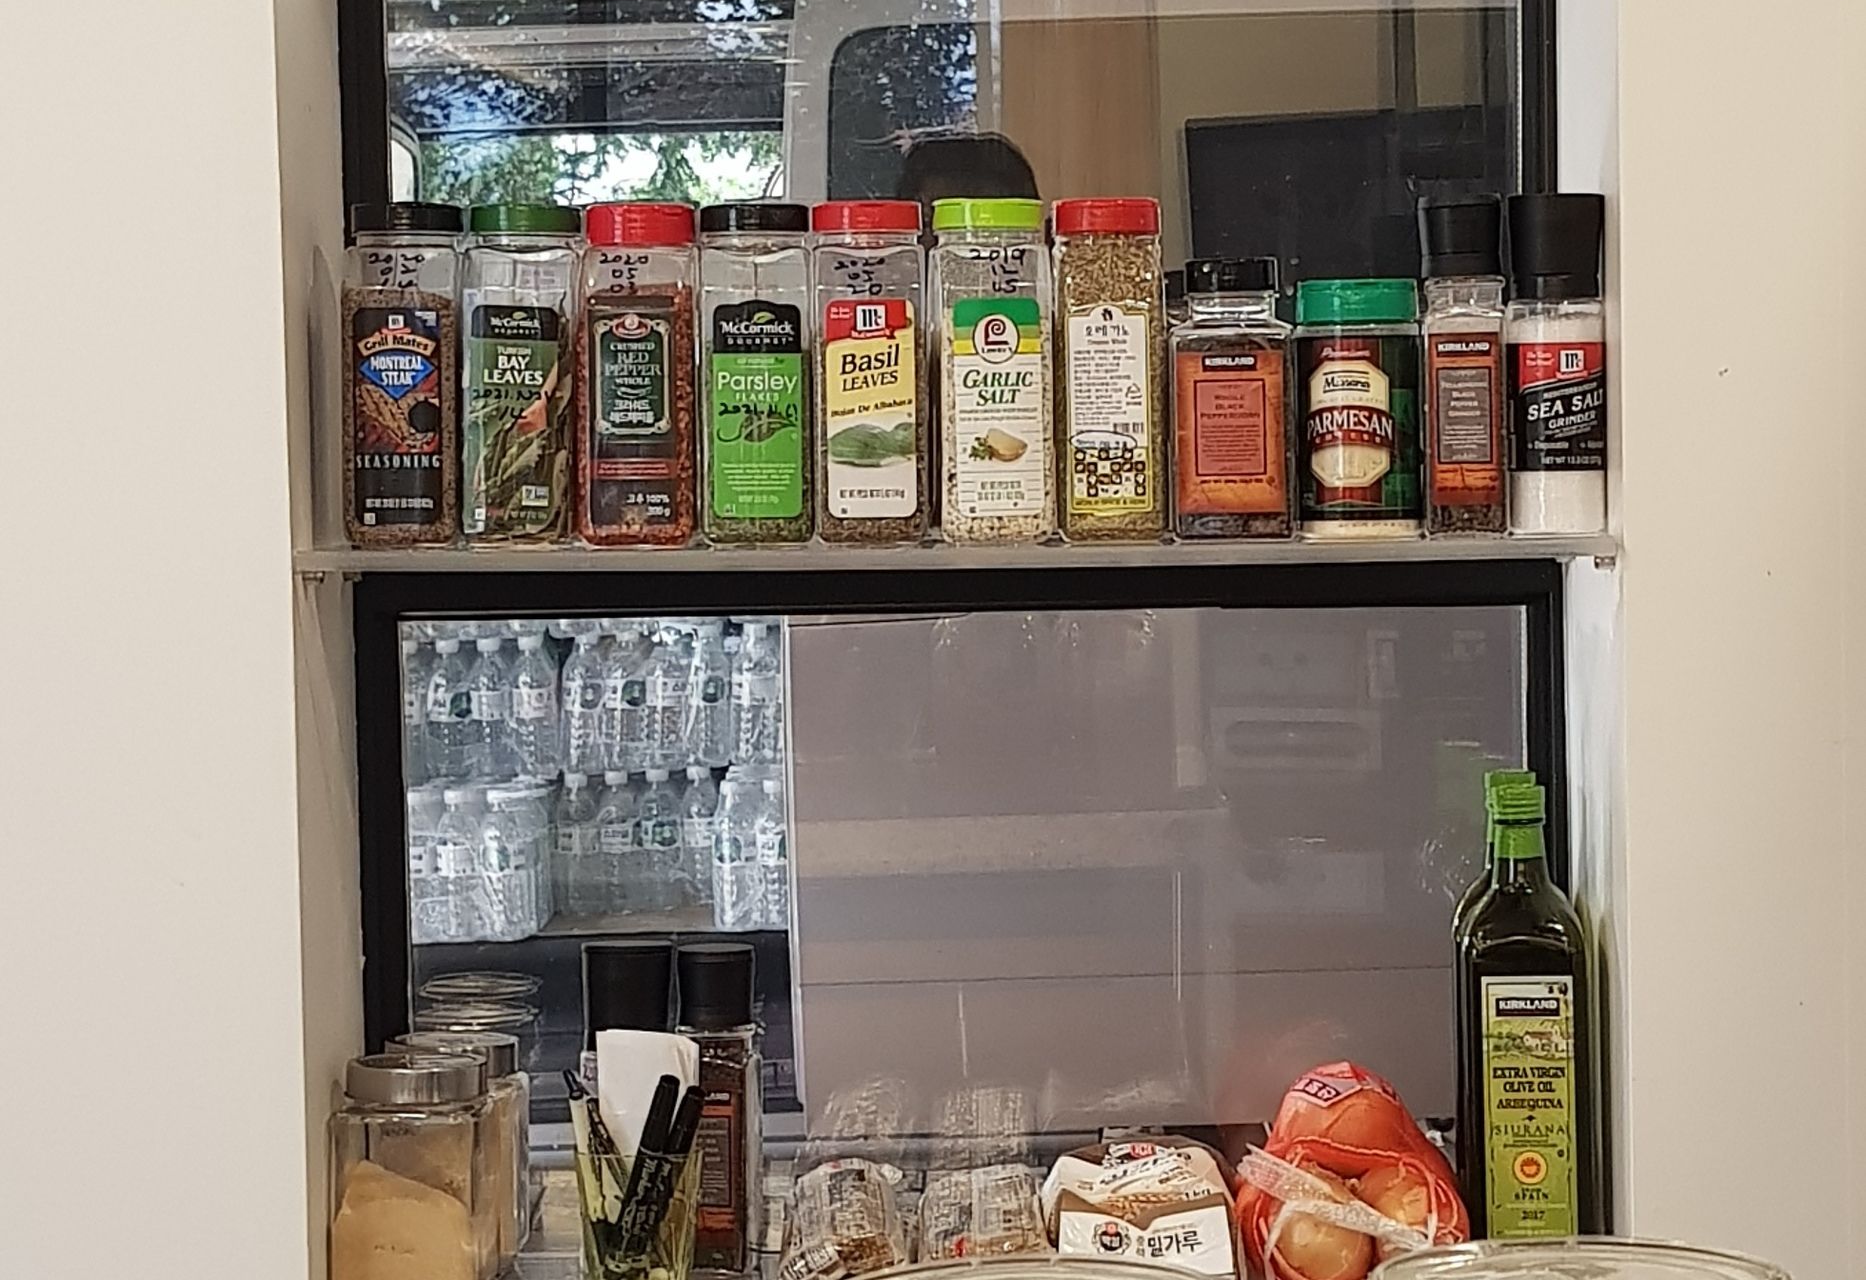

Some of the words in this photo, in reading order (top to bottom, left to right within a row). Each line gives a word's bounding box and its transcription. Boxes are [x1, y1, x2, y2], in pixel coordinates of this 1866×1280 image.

[599, 253, 649, 266] 2020
[969, 248, 1026, 266] 2019
[611, 268, 639, 280] 05
[846, 284, 883, 296] 20
[719, 320, 795, 335] McCormick
[364, 334, 389, 351] Grill
[392, 336, 429, 351] Mates
[1437, 342, 1490, 352] KIRKLAND
[370, 355, 424, 371] MONTREAL
[498, 355, 530, 370] BAY
[617, 352, 650, 364] RED
[840, 343, 900, 376] Basil
[1204, 356, 1255, 366] KIRKLAND
[483, 369, 544, 385] LEAVES
[605, 364, 662, 376] PEPPER
[381, 371, 416, 386] STEAK
[717, 371, 798, 394] Parsley
[842, 371, 898, 392] LEAVES
[963, 369, 1034, 389] GARLIC
[976, 388, 1021, 407] SALT
[1527, 399, 1564, 421] SEA
[1307, 409, 1393, 440] PARMESAN
[1548, 410, 1596, 429] GRINDER
[356, 454, 441, 469] SEASONING
[1499, 1000, 1558, 1010] KIRKLAND
[1492, 1067, 1528, 1079] EXTRA
[1529, 1067, 1566, 1079] VIRGIN
[1503, 1082, 1535, 1093] OLIVE
[1537, 1082, 1556, 1093] OIL
[1494, 1124, 1566, 1136] SIURANA
[1147, 1230, 1203, 1258] 밀가루
